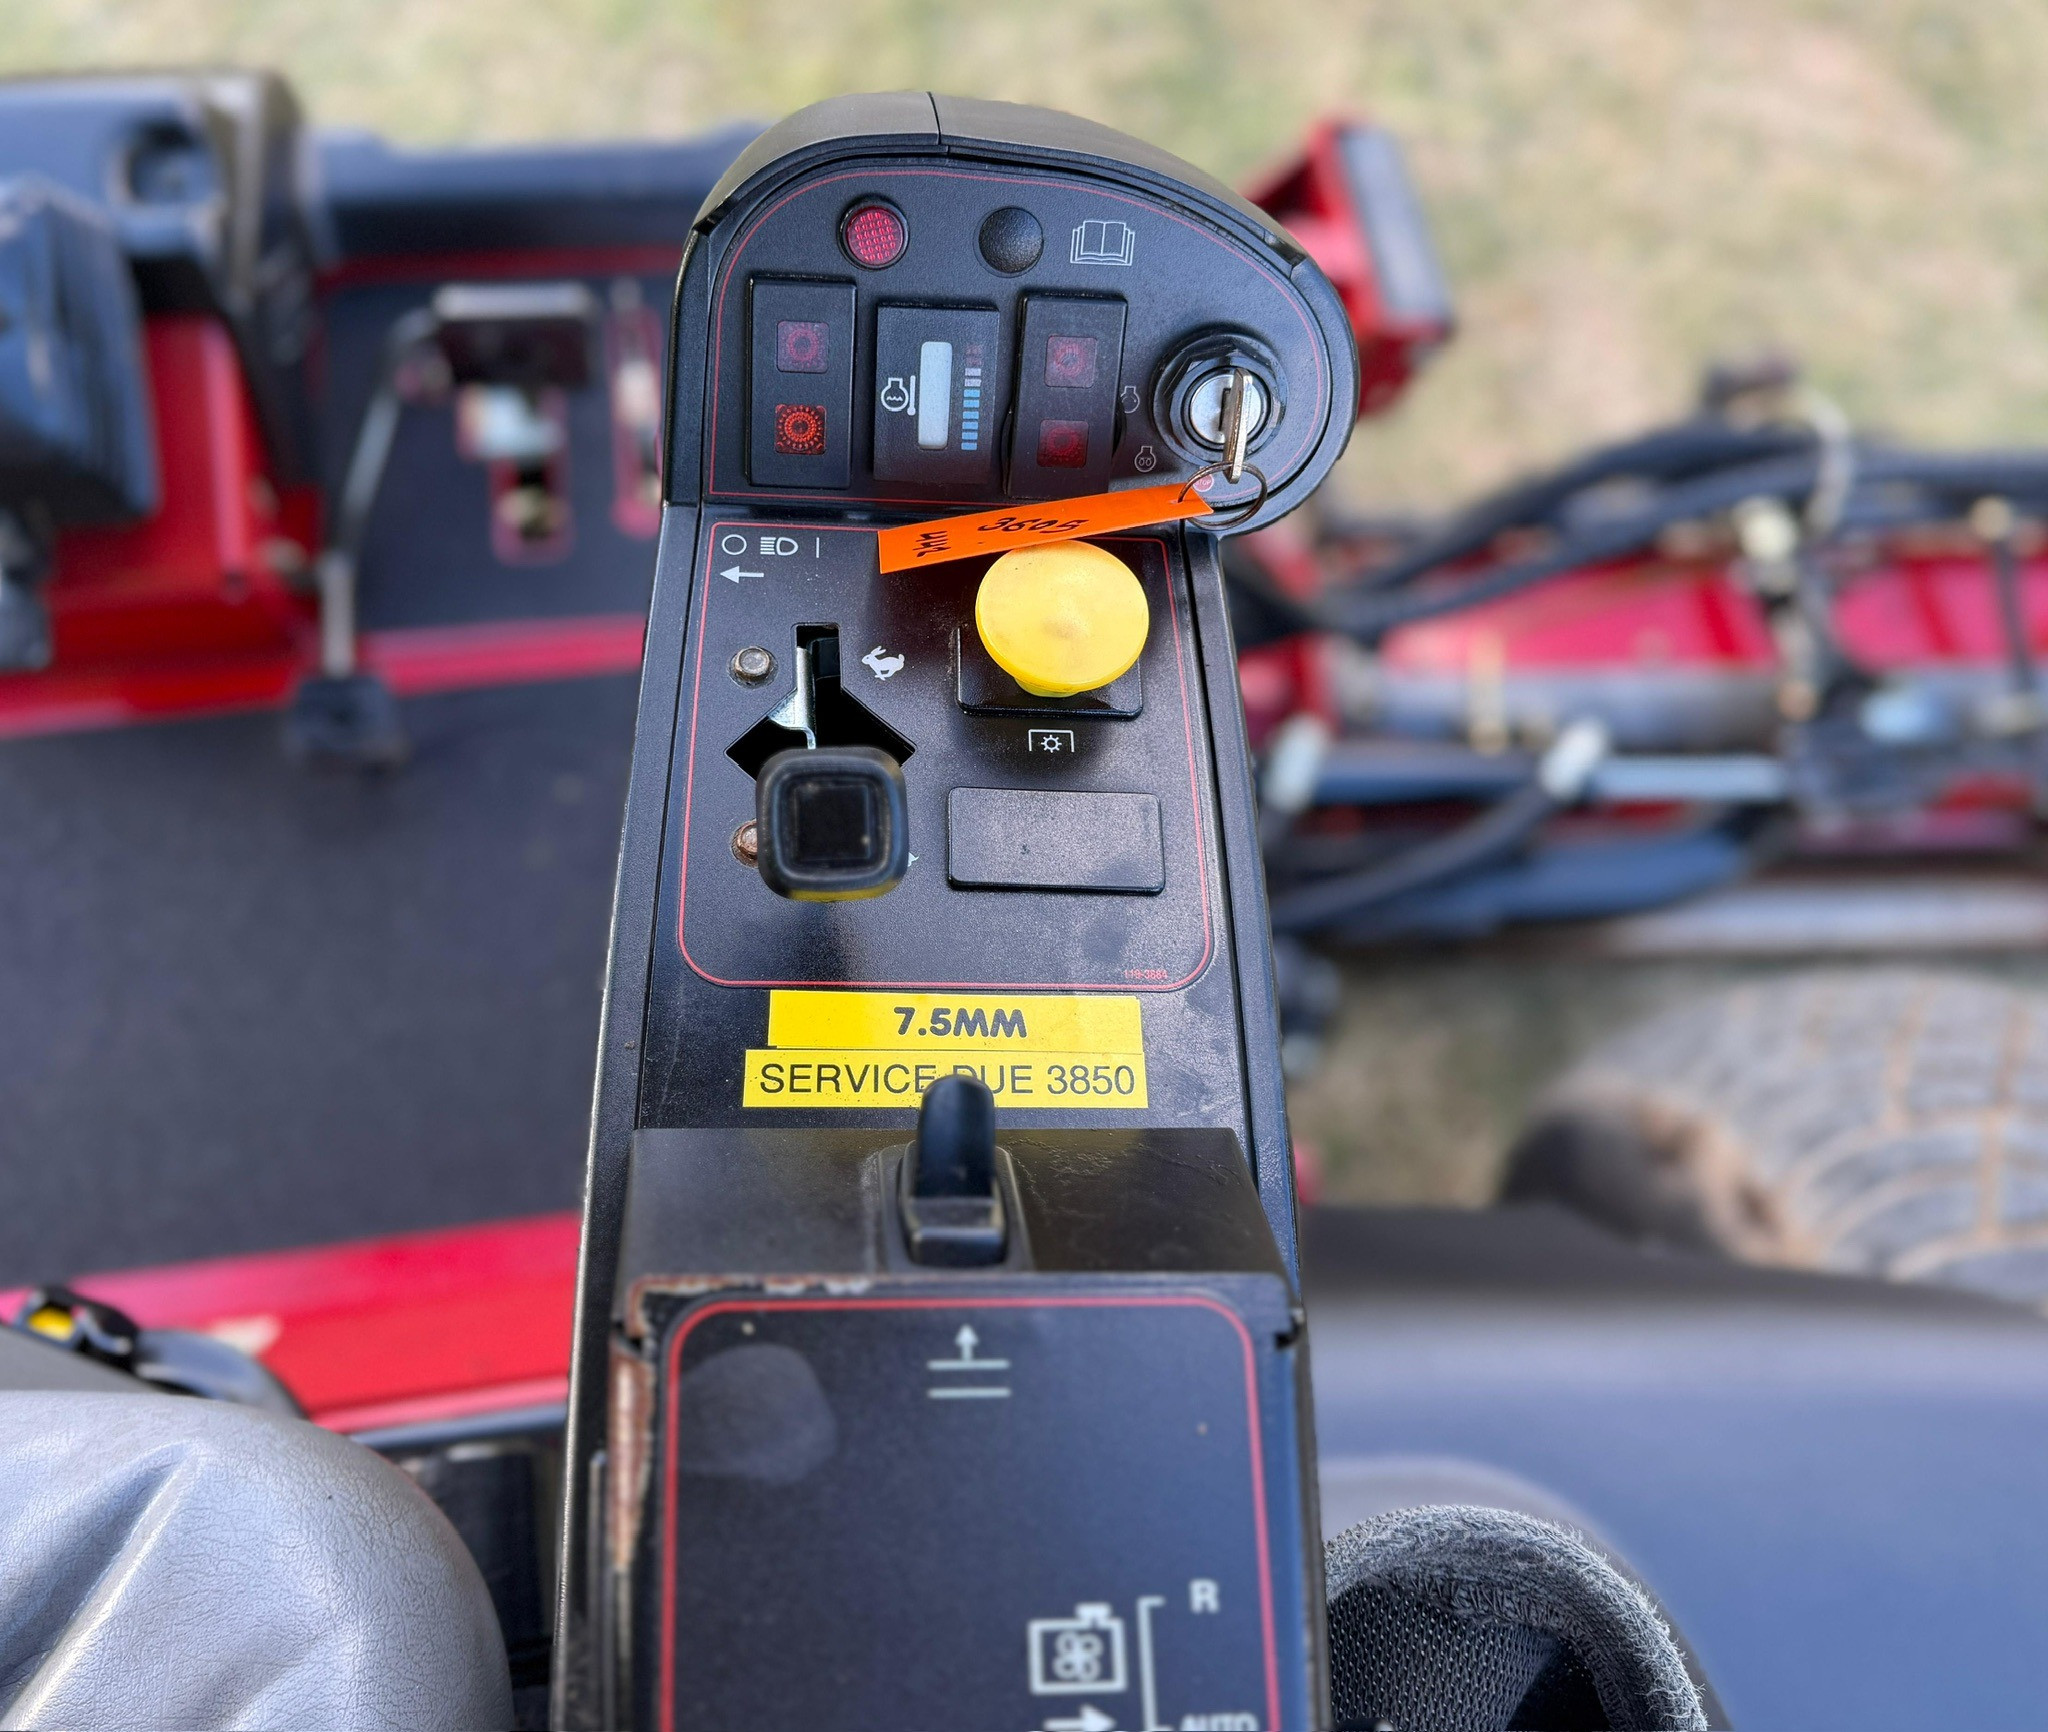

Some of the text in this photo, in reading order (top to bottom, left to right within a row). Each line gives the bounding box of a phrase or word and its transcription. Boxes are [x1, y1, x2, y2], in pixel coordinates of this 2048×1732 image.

[977, 516, 1090, 535] 3605
[893, 1006, 1028, 1039] 7.5MM
[759, 1063, 937, 1095] SERVICE
[1047, 1064, 1136, 1096] 3850
[1188, 1578, 1220, 1614] R
